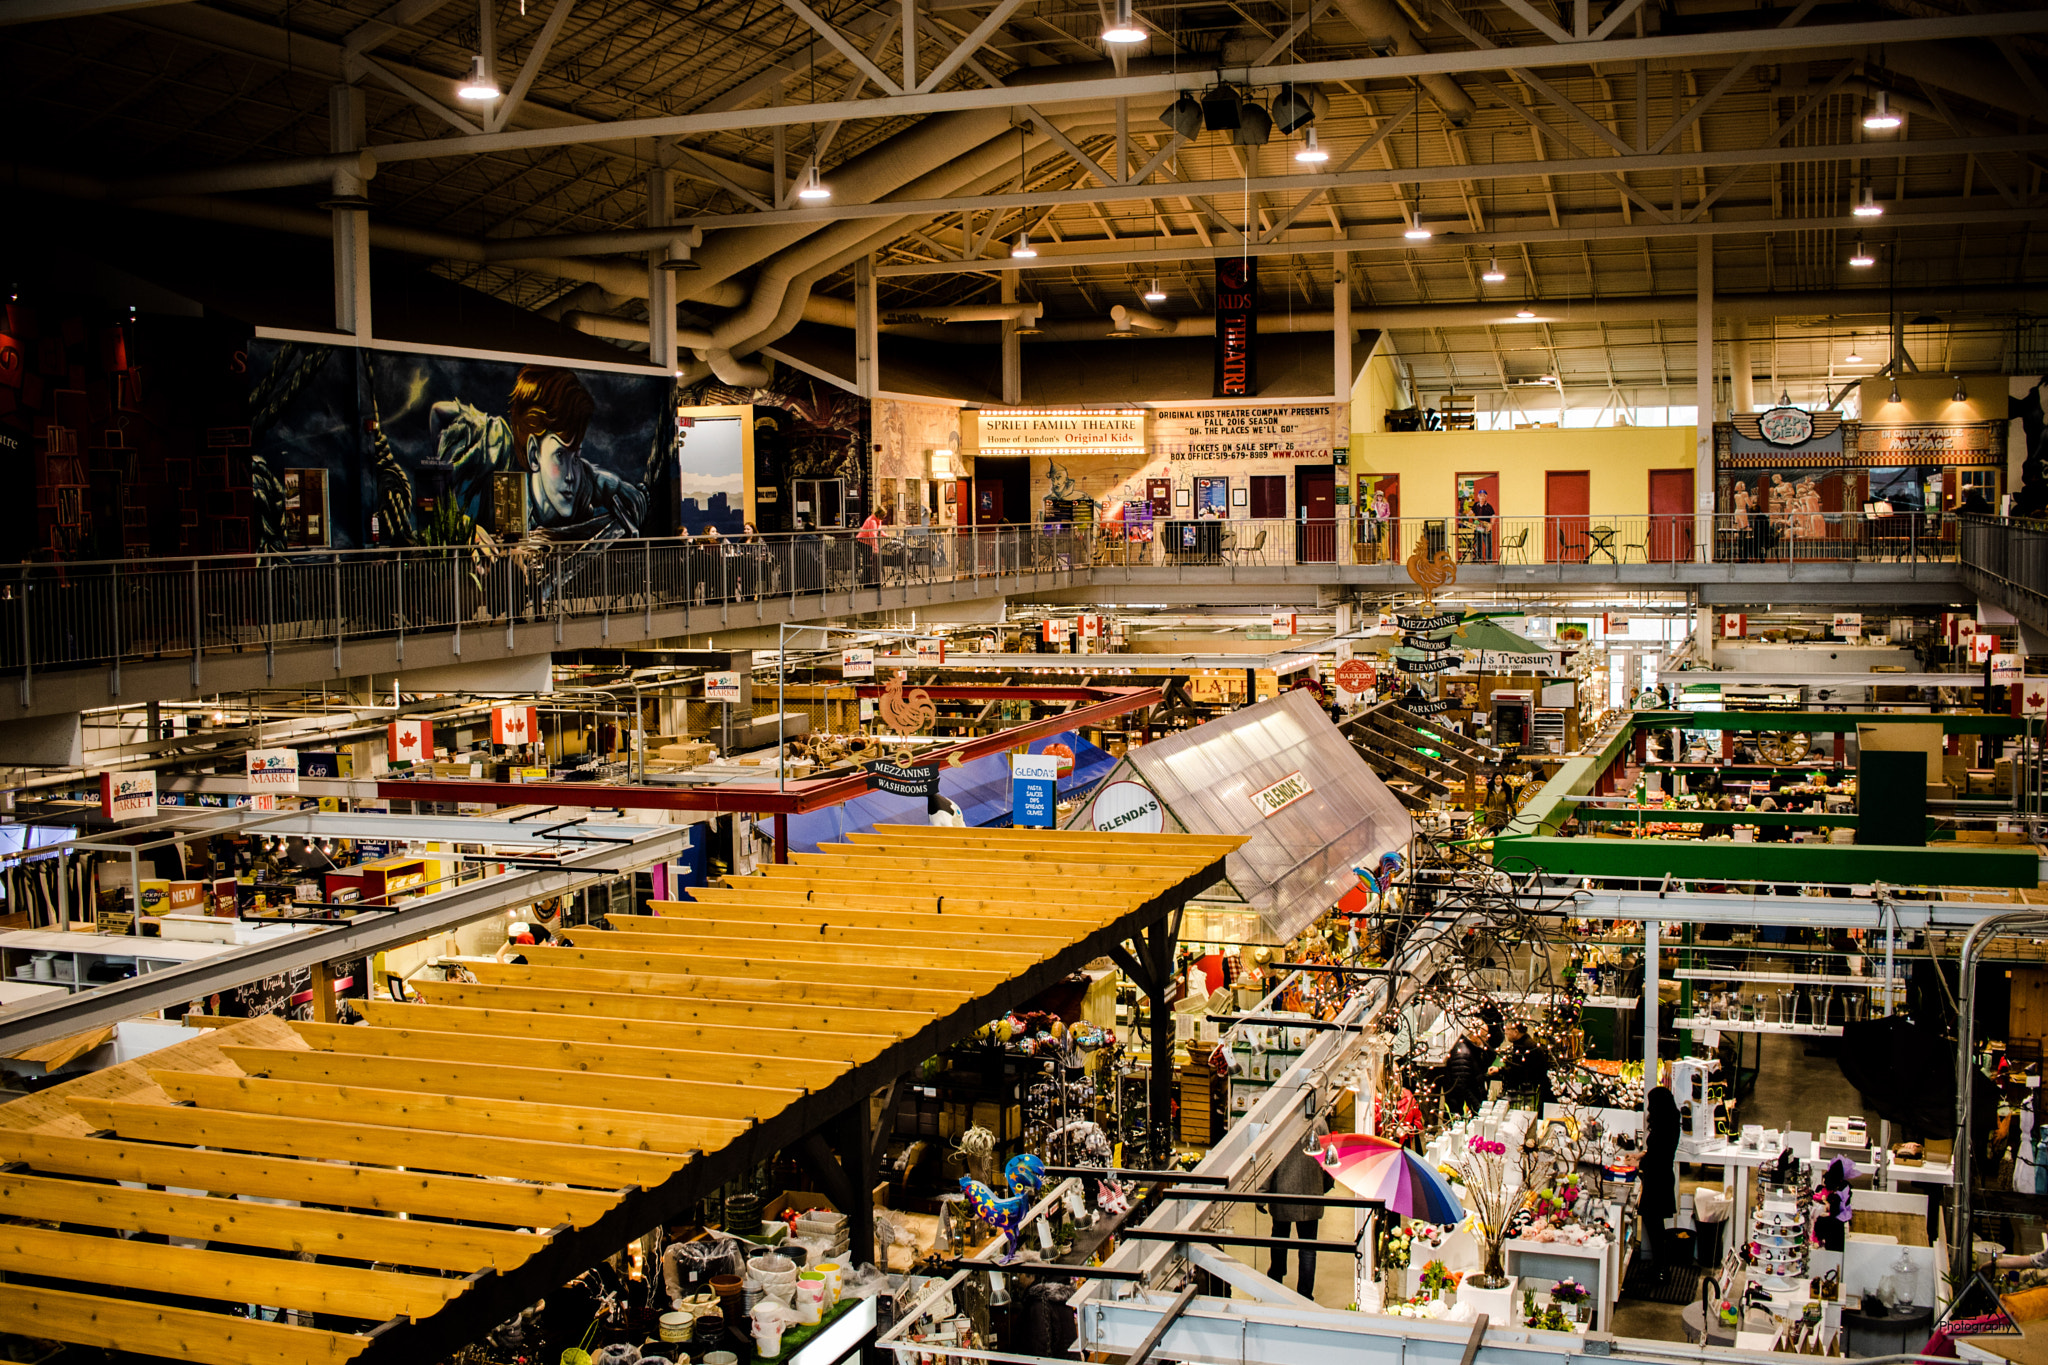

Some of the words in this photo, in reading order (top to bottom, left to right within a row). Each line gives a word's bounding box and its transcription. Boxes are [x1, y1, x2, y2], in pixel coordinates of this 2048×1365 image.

[1217, 293, 1252, 309] KIDS
[1223, 313, 1246, 395] THEATRE
[1158, 411, 1195, 419] ORIGINAL
[1197, 410, 1215, 418] KIDS
[1217, 409, 1250, 418] THEATRE
[1251, 408, 1289, 417] COMPANY
[1291, 407, 1330, 416] PRESENTS
[987, 420, 1029, 431] SPRIET
[1033, 420, 1078, 431] FAMILY
[1081, 420, 1136, 430] THEATRE
[1204, 418, 1224, 427] FALL
[1227, 418, 1246, 426] 2016
[1249, 417, 1279, 426] SEASON
[1765, 416, 1810, 430] CARPE
[1205, 427, 1219, 435] THE
[1221, 426, 1250, 435] PLACES
[1252, 426, 1277, 434] WE'LL
[1770, 427, 1806, 440] DIEM
[1881, 430, 1892, 439] IN
[1893, 429, 1921, 438] CHAIR
[1932, 428, 1964, 438] TABLE
[987, 435, 1011, 444] Home
[1012, 435, 1021, 443] of
[1024, 435, 1060, 444] London's
[1064, 433, 1108, 445] Original
[1111, 433, 1134, 443] Kids
[1889, 438, 1954, 450] MASSAGE
[1188, 444, 1219, 452] TICKETS
[1222, 444, 1232, 452] ON
[1236, 443, 1256, 451] SALE
[1259, 442, 1282, 451] SEPT.
[1285, 442, 1295, 450] 26
[1170, 452, 1186, 461] BOX
[1272, 450, 1329, 459] WWW.OKTC.CA
[1401, 615, 1457, 629] MEZZANINE
[1409, 637, 1446, 650] WASHROOMS
[1408, 659, 1449, 671] ELEVATOR
[1497, 653, 1554, 667] Treasury
[1993, 670, 2021, 680] MARKET
[707, 689, 738, 697] MARKET
[1408, 702, 1448, 713] PARKING
[874, 762, 931, 778] MEZZANINE
[1014, 767, 1056, 778] GLENDA'S
[251, 773, 296, 785] MARKET
[878, 778, 928, 794] WASHROOMS
[1263, 778, 1304, 809] GLENDA'S
[258, 795, 273, 810] EXIT
[1026, 809, 1044, 817] OLIVES
[1098, 800, 1159, 832] GLENDA'S
[172, 887, 196, 904] NEW
[219, 895, 233, 903] WIN
[220, 900, 234, 910] NOW
[234, 981, 260, 1004] Real
